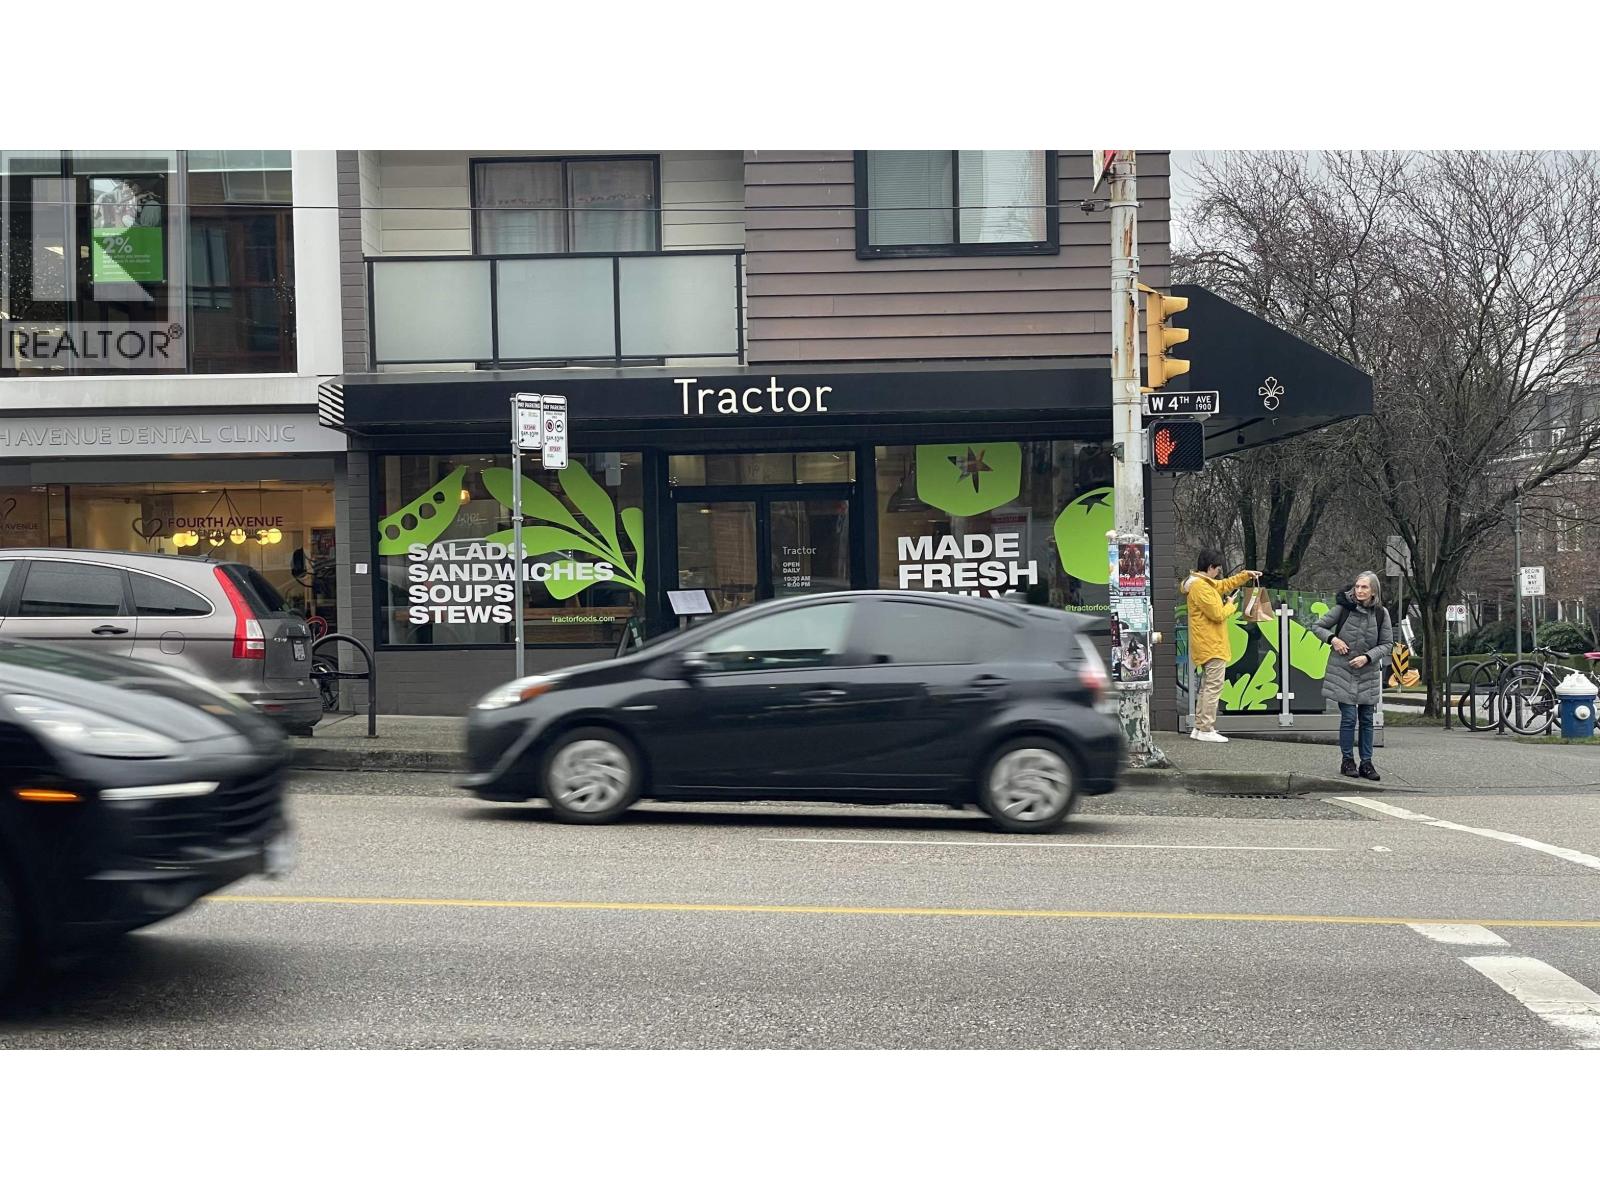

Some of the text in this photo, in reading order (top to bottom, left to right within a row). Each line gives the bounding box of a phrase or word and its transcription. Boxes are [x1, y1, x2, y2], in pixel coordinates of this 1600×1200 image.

[674, 376, 833, 415] Tractor
[1151, 396, 1212, 411] W 4TH AVE
[14, 427, 112, 446] AVENUE
[118, 425, 211, 445] DENTAL
[217, 424, 296, 443] CLINIC
[168, 516, 284, 528] FOURTH AVENUE
[407, 542, 528, 562] SALADS
[782, 546, 817, 555] Tractor
[897, 533, 1020, 561] MADE
[408, 562, 614, 582] SANDWICHES
[898, 560, 1038, 589] FRESH
[408, 583, 515, 604] SOUPS
[408, 605, 513, 624] STEWS
[551, 615, 616, 623] tractorfoods.com
